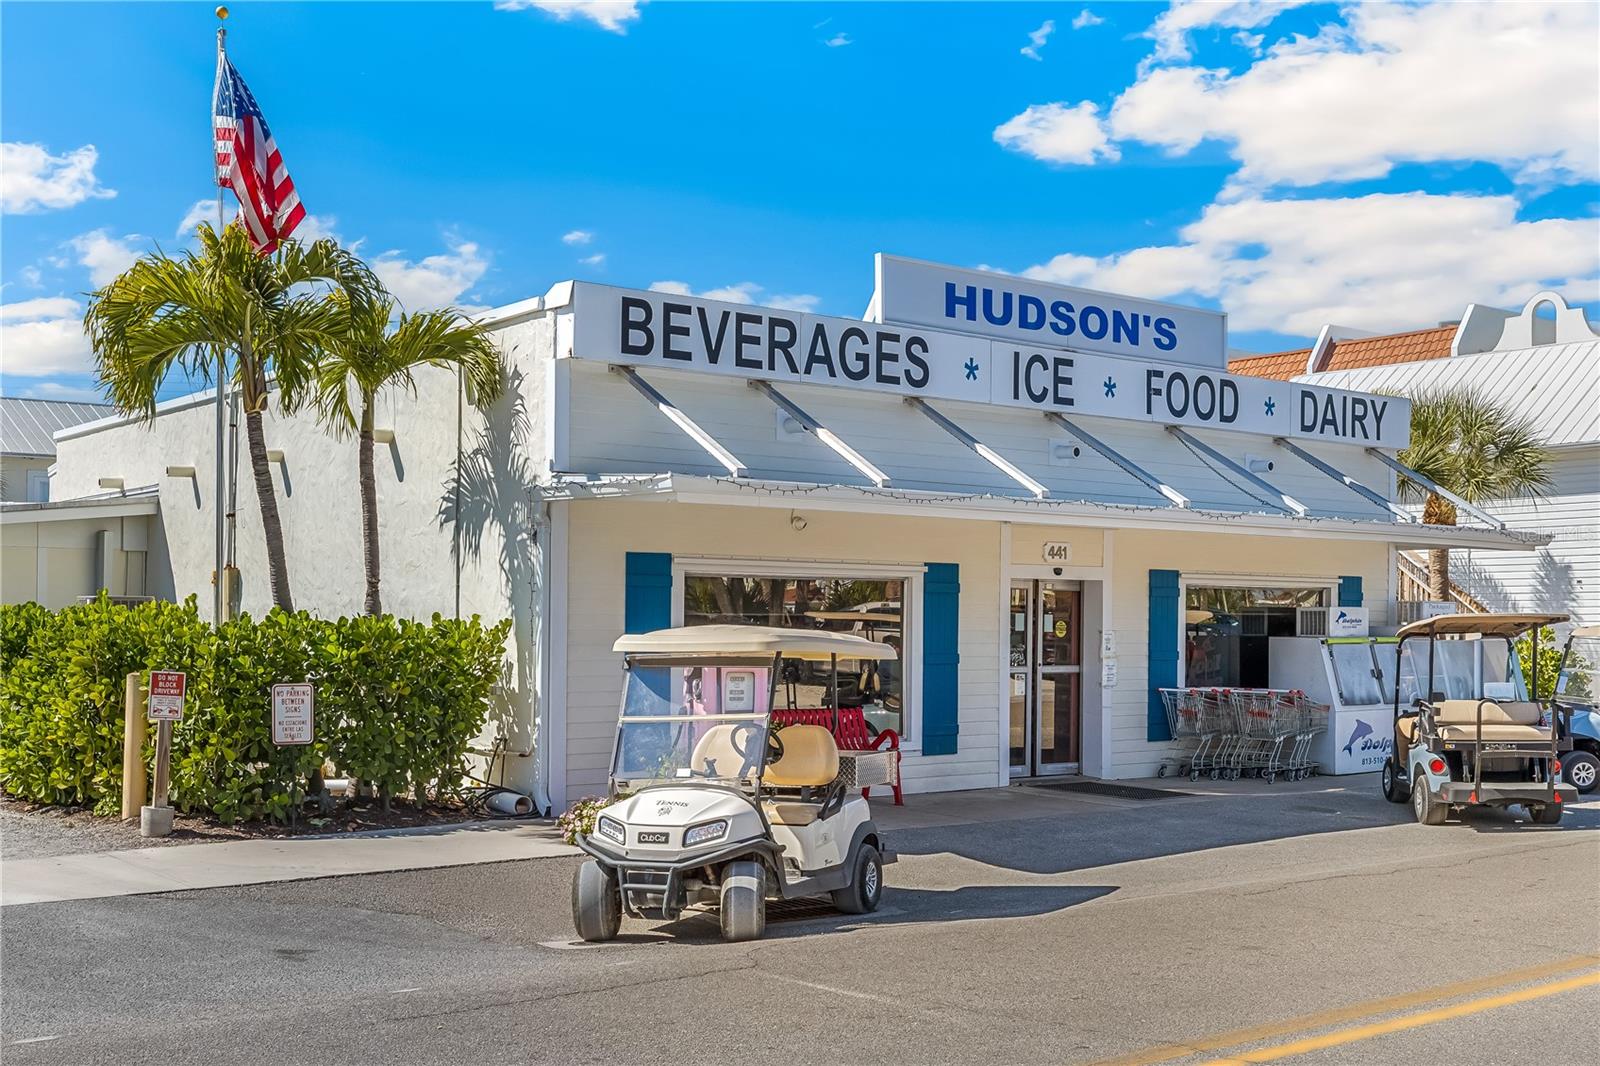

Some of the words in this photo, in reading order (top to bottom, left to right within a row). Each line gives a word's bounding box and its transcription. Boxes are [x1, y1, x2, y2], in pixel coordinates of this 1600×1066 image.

[945, 281, 1178, 351] HUDSON'S
[621, 296, 930, 389] BEVERAGES
[1013, 351, 1075, 406] ICE
[1146, 369, 1240, 423] FOOD
[1300, 390, 1389, 441] DAIRY
[1047, 545, 1068, 560] 441
[276, 690, 284, 698] NO
[286, 689, 310, 697] PARKING
[281, 698, 305, 706] BETWEEN
[285, 705, 302, 713] SIGNS
[656, 800, 689, 808] TENNIS
